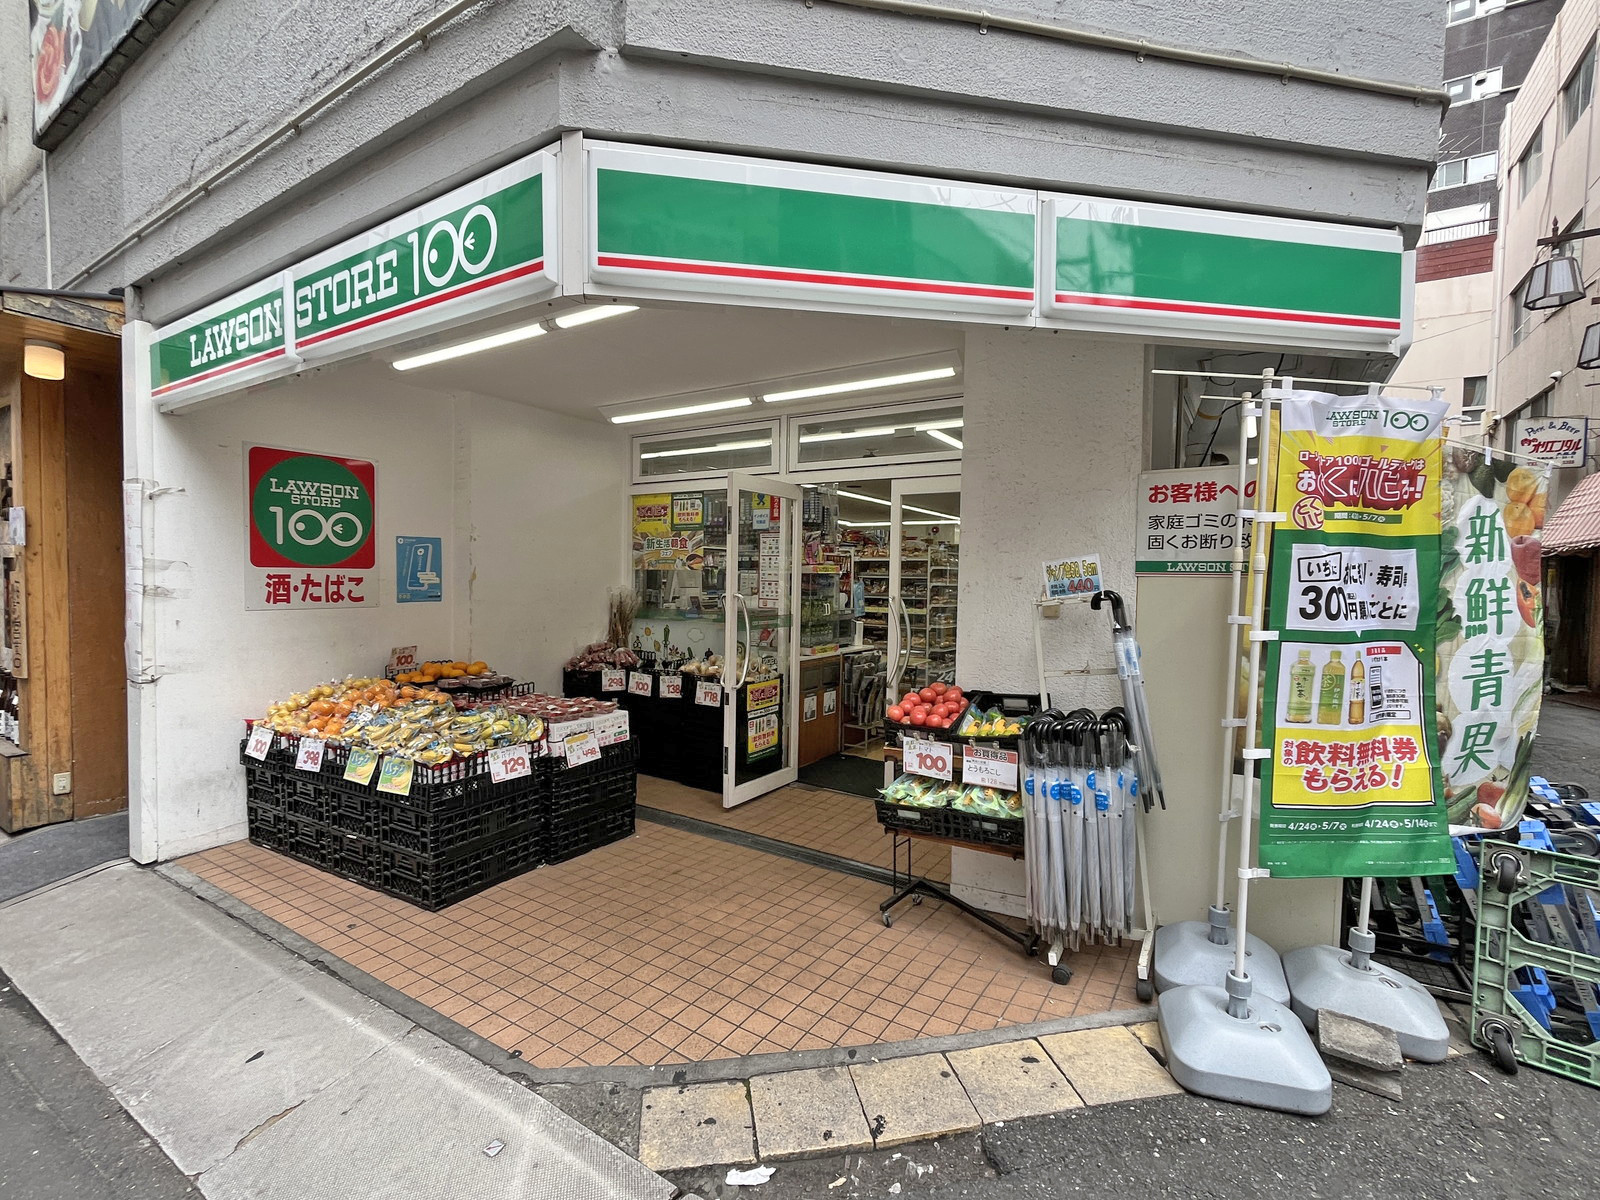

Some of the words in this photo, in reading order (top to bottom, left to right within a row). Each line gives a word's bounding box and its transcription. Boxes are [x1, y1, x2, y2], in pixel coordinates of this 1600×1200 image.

[189, 298, 284, 368] LAWSON
[296, 249, 398, 329] STORE
[407, 203, 498, 296] 100
[1332, 419, 1367, 427] STORE
[1382, 410, 1429, 432] 100
[1548, 421, 1557, 429] &
[269, 477, 360, 500] LAWSON
[291, 494, 341, 508] STORE
[268, 506, 363, 548] 100
[646, 537, 689, 550] 新生活朝食
[1167, 562, 1227, 572] LAWSON
[264, 573, 366, 605] 酒・たばこ
[1067, 578, 1094, 592] 440
[1451, 505, 1513, 779] 新鮮青果
[396, 654, 413, 666] 100
[635, 680, 649, 692] 100
[666, 684, 681, 695] 138
[253, 739, 268, 755] 100
[1295, 737, 1418, 767] 飲料無料券
[304, 750, 321, 766] 398
[501, 756, 526, 775] 129
[915, 752, 947, 773] 100
[967, 765, 1002, 777] とうもろこし
[1303, 763, 1403, 792] もらえる!
